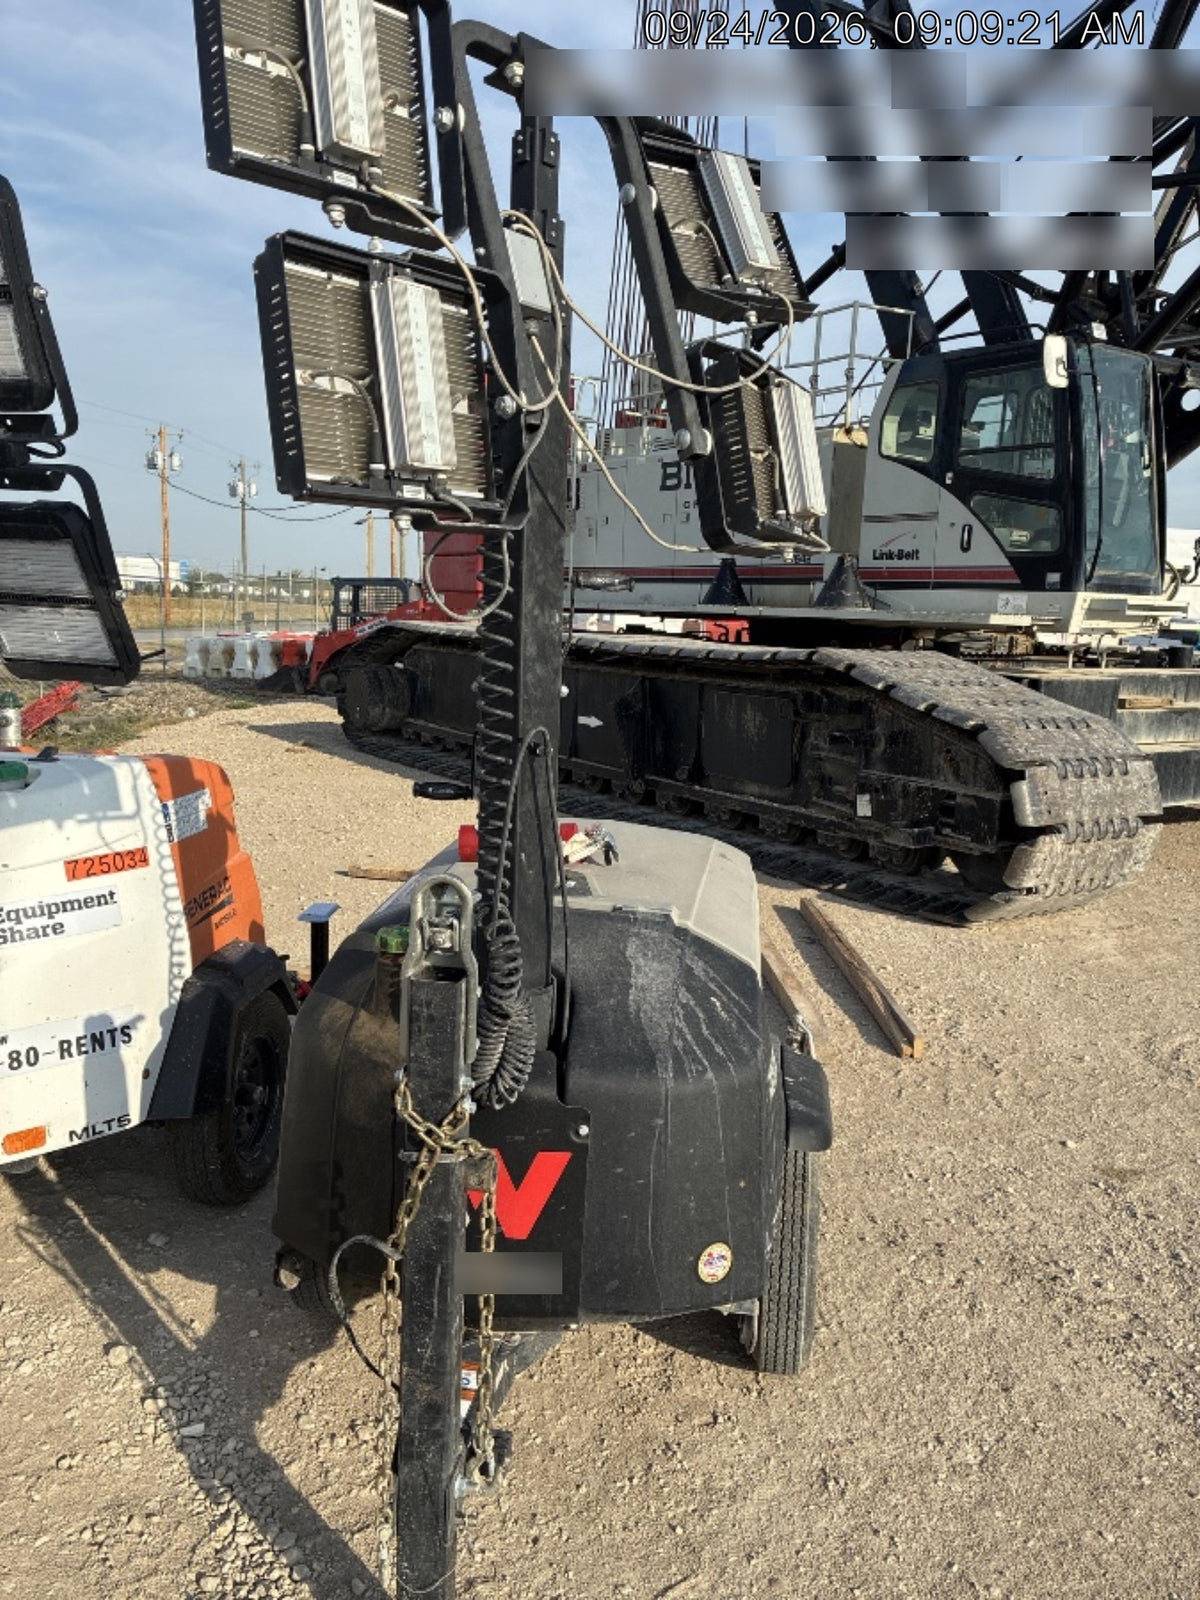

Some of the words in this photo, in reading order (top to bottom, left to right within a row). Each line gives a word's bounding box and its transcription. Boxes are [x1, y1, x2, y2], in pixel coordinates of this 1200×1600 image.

[872, 549, 920, 561] Link-Belt
[66, 848, 148, 880] 725034
[0, 890, 118, 925] Equipment
[0, 922, 66, 945] Share
[68, 1114, 132, 1142] MLTS
